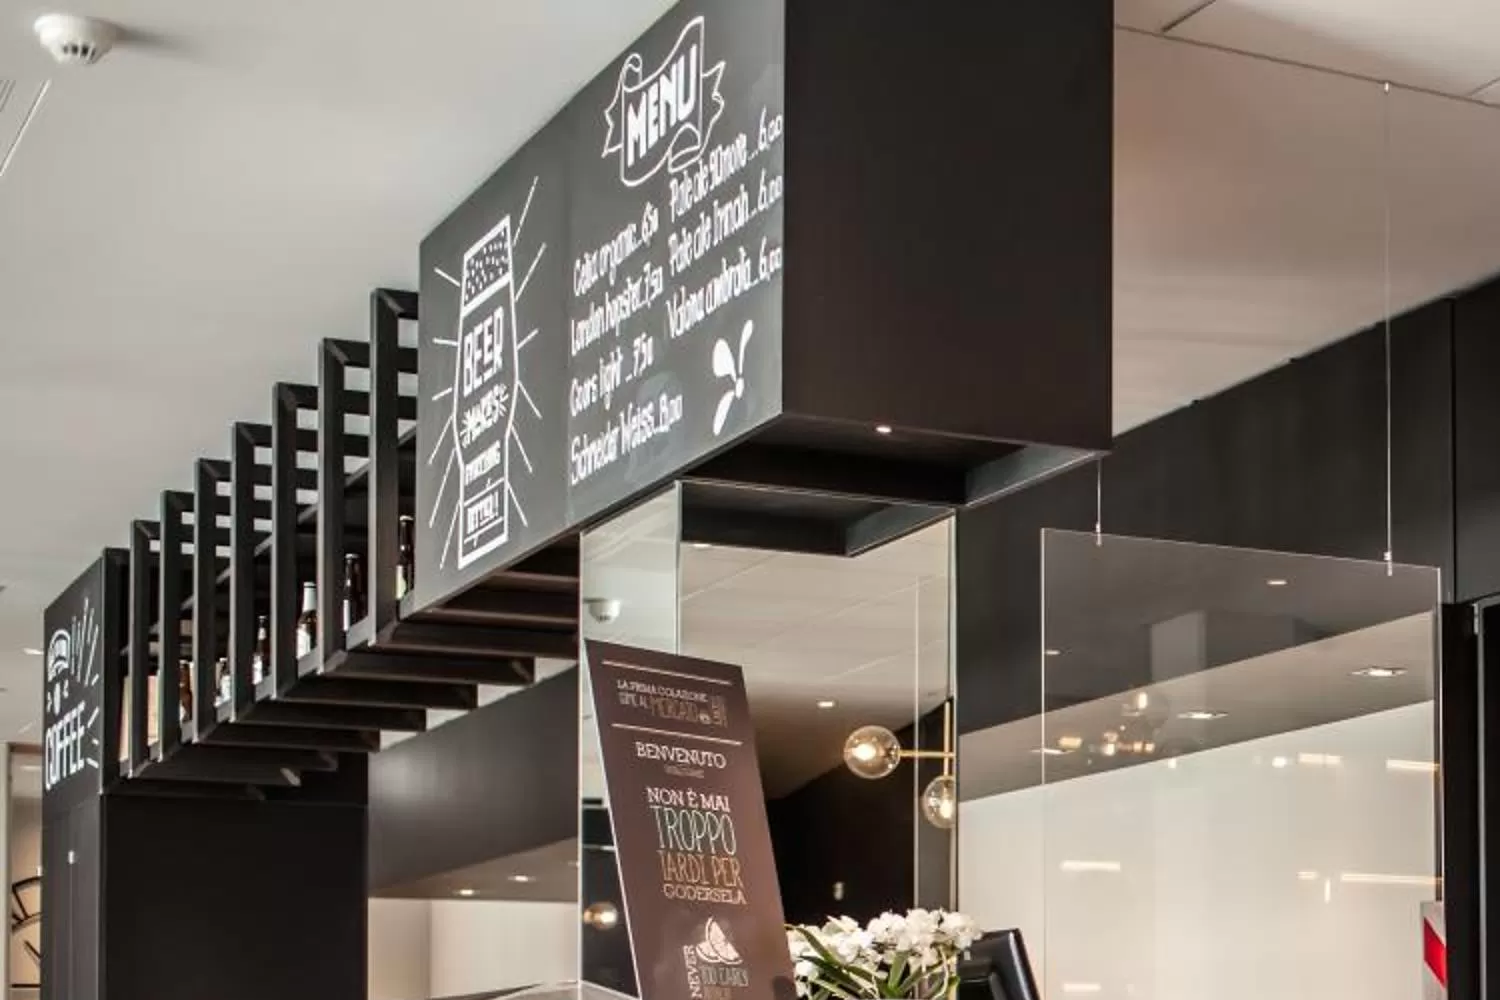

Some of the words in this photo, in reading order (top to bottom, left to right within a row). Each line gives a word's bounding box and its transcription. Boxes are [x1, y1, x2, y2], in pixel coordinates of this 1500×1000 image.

[627, 43, 698, 168] MENU
[463, 305, 504, 398] BEER
[635, 741, 727, 769] BENVENUTO
[646, 786, 685, 806] NON
[700, 793, 731, 813] MAI
[649, 805, 737, 855] TROPPO
[656, 849, 710, 885] TARDI
[711, 855, 746, 889] PER
[662, 883, 748, 905] GODERSELA
[683, 945, 702, 1000] NEVER
